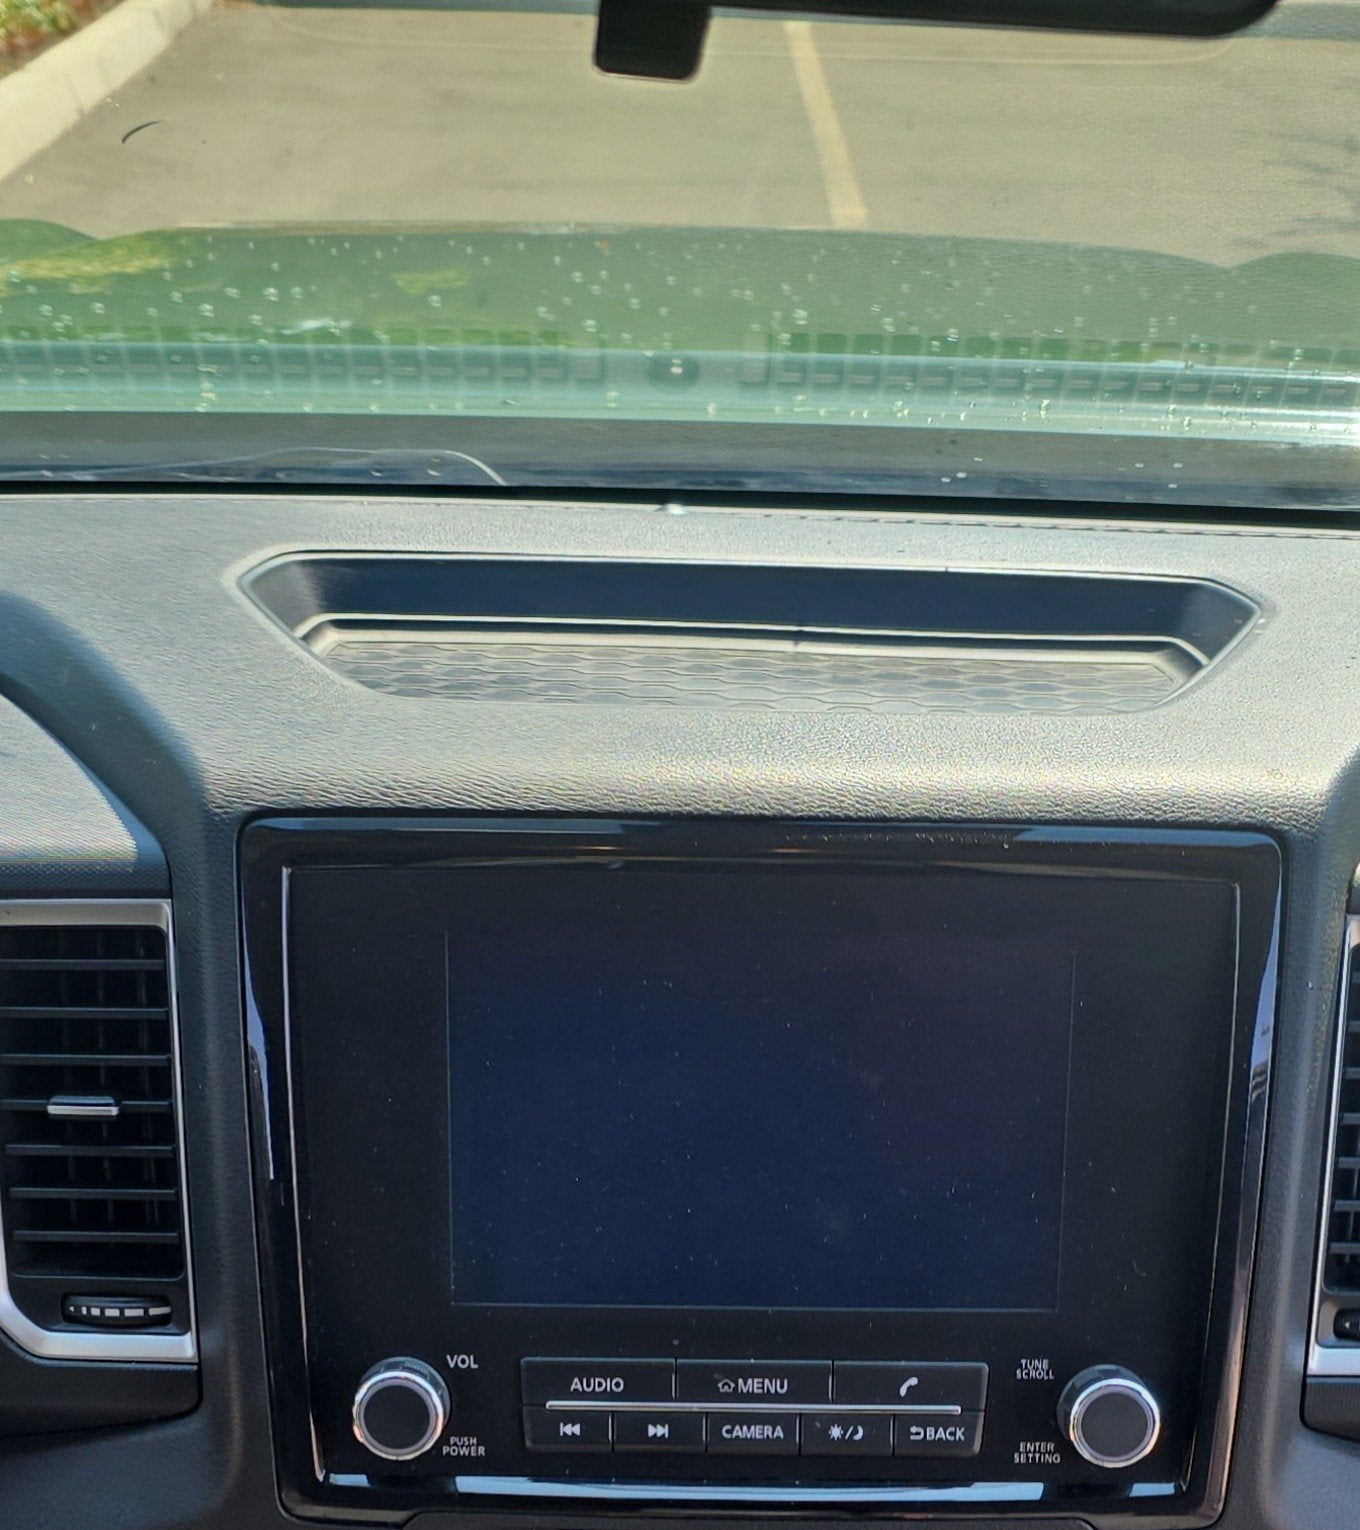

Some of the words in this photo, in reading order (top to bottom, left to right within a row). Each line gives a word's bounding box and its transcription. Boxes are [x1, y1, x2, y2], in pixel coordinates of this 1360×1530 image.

[446, 1354, 478, 1369] VOL
[1021, 1359, 1049, 1370] TUNE
[1016, 1368, 1054, 1380] SCROLL
[570, 1377, 624, 1393] AUDIO
[738, 1378, 788, 1394] MENU
[722, 1425, 784, 1440] CAMERA
[926, 1427, 965, 1441] BACK
[450, 1436, 477, 1447] PUSH
[1020, 1442, 1054, 1453] ENTER
[442, 1446, 485, 1457] POWER
[1014, 1452, 1061, 1464] SETTING
